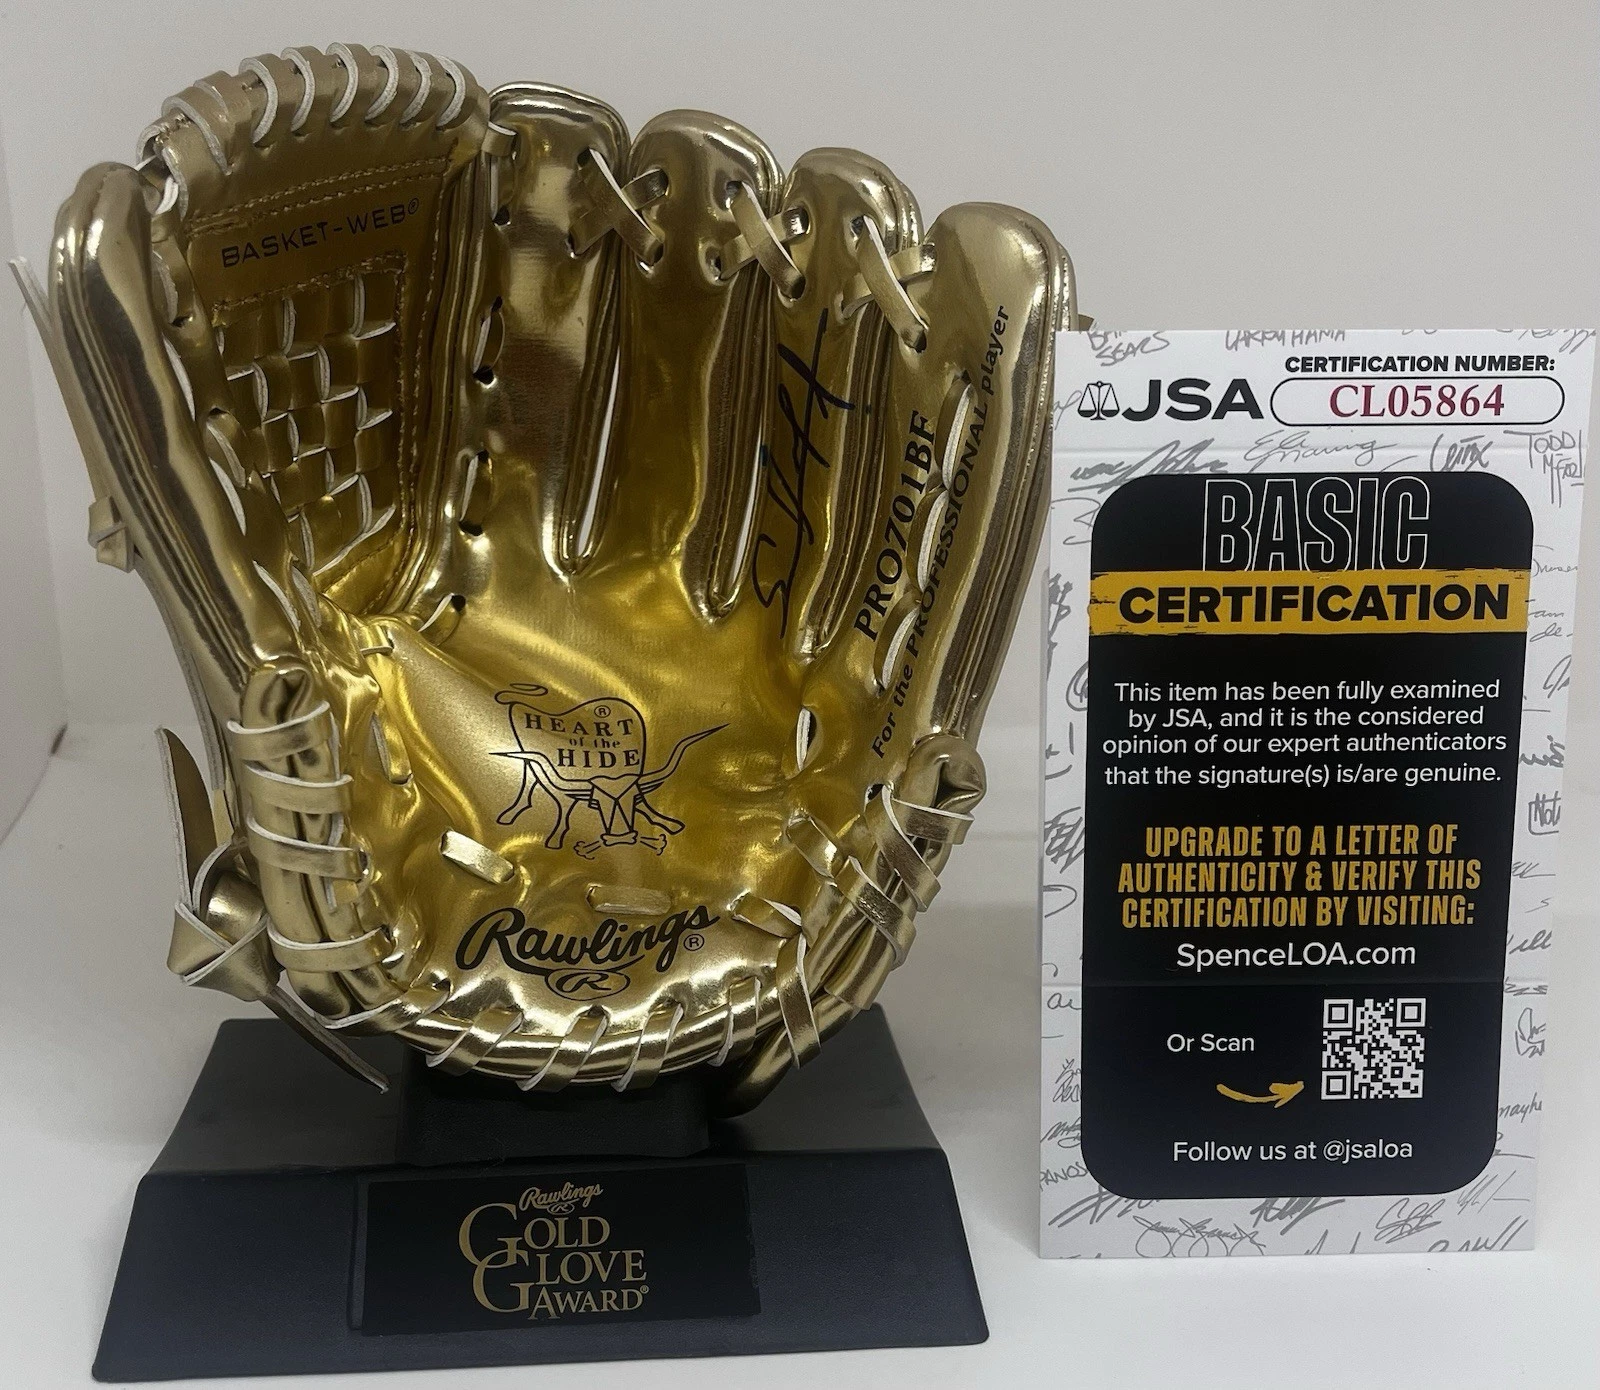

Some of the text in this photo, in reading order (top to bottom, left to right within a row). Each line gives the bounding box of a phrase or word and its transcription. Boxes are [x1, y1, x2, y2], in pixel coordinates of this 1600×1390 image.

[1284, 354, 1556, 374] CERTIFICATION NUMBER:
[1121, 377, 1265, 422] JSA
[1328, 383, 1505, 419] CL05864
[853, 410, 937, 642] PRO701BF
[871, 305, 1010, 759] For the PROFESSIONAL player
[1202, 475, 1431, 572] BASIC
[1118, 583, 1510, 626] CERTIFICATION
[1114, 678, 1501, 706] This item has been fully examined
[524, 712, 635, 738] HEART
[1128, 705, 1484, 733] by JSA, and it is the considered
[556, 748, 641, 769] HIDE
[569, 736, 621, 749] of the
[1102, 734, 1187, 757] opinion
[1194, 733, 1219, 754] of
[1223, 738, 1262, 753] our
[1267, 734, 1340, 757] expert
[1346, 731, 1507, 752] authenticators
[1104, 762, 1501, 789] that the signature(s) is/are genuine.
[1145, 823, 1458, 858] UPGRADE TO A LETTER OF
[1118, 861, 1297, 893] AUTHENTICITY
[1305, 861, 1323, 892] &
[1331, 860, 1418, 891] VERIFY
[1426, 859, 1482, 891] THIS
[1122, 894, 1475, 929] CERTIFICATION BY VISITING:
[455, 905, 720, 973] Rawlings
[1176, 941, 1416, 973] SpenceLOA.com
[1166, 1033, 1255, 1053] Or Scan
[1173, 1138, 1413, 1164] Follow us at @jsaloa
[519, 1181, 604, 1212] Rawlings
[458, 1203, 611, 1269] GOLD
[472, 1248, 648, 1314] GLOVE
